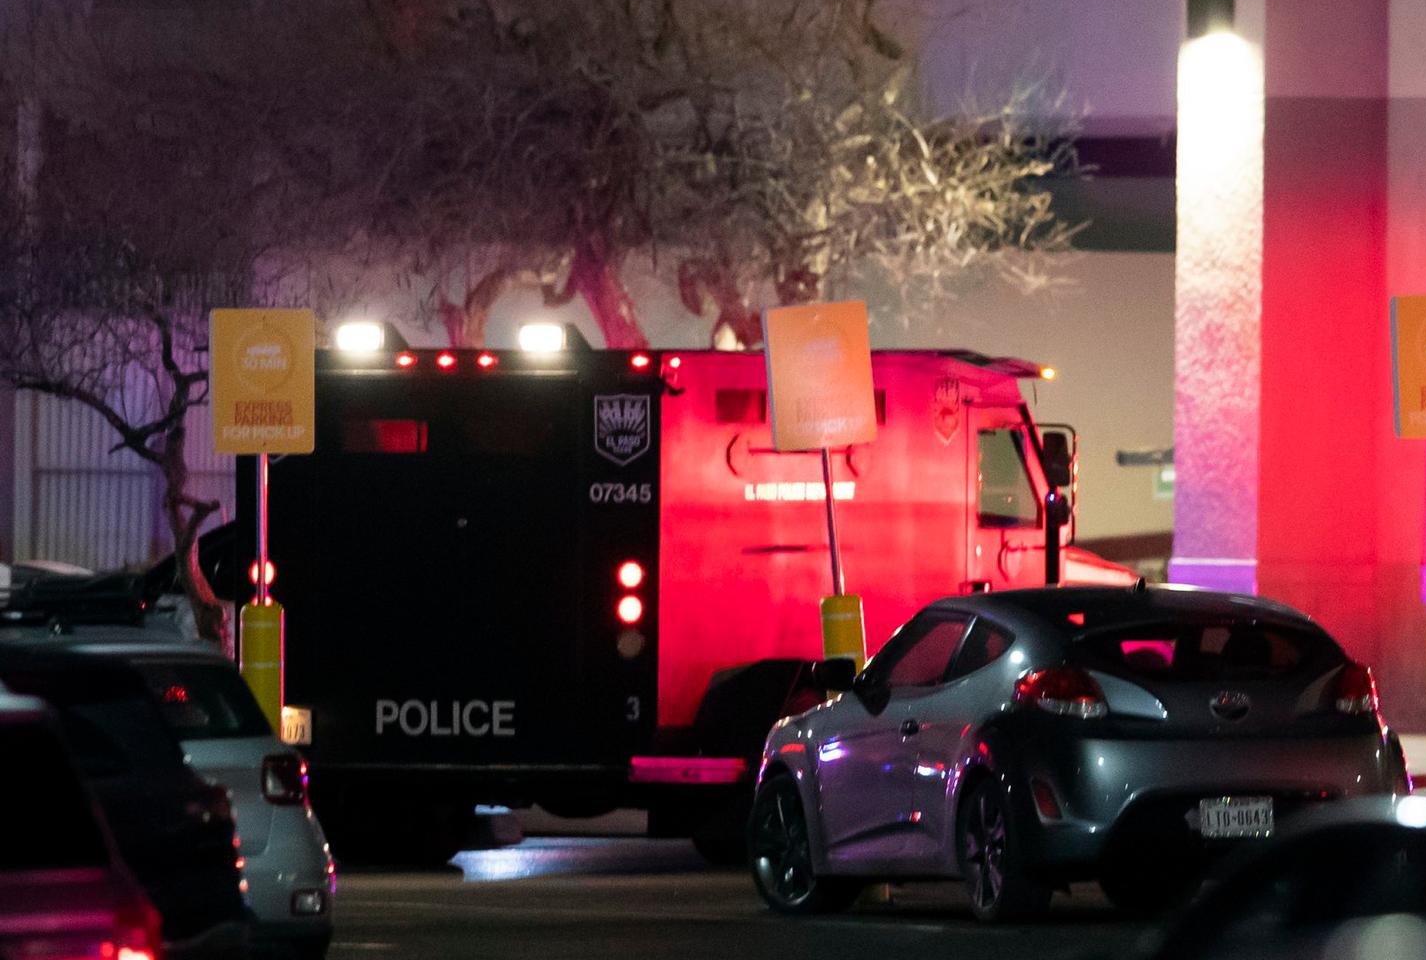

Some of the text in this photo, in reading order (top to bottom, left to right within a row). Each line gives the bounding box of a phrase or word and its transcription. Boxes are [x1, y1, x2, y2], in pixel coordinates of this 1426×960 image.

[288, 425, 305, 439] UP
[589, 483, 652, 503] 07345
[375, 699, 516, 736] POLICE
[625, 696, 641, 721] 3
